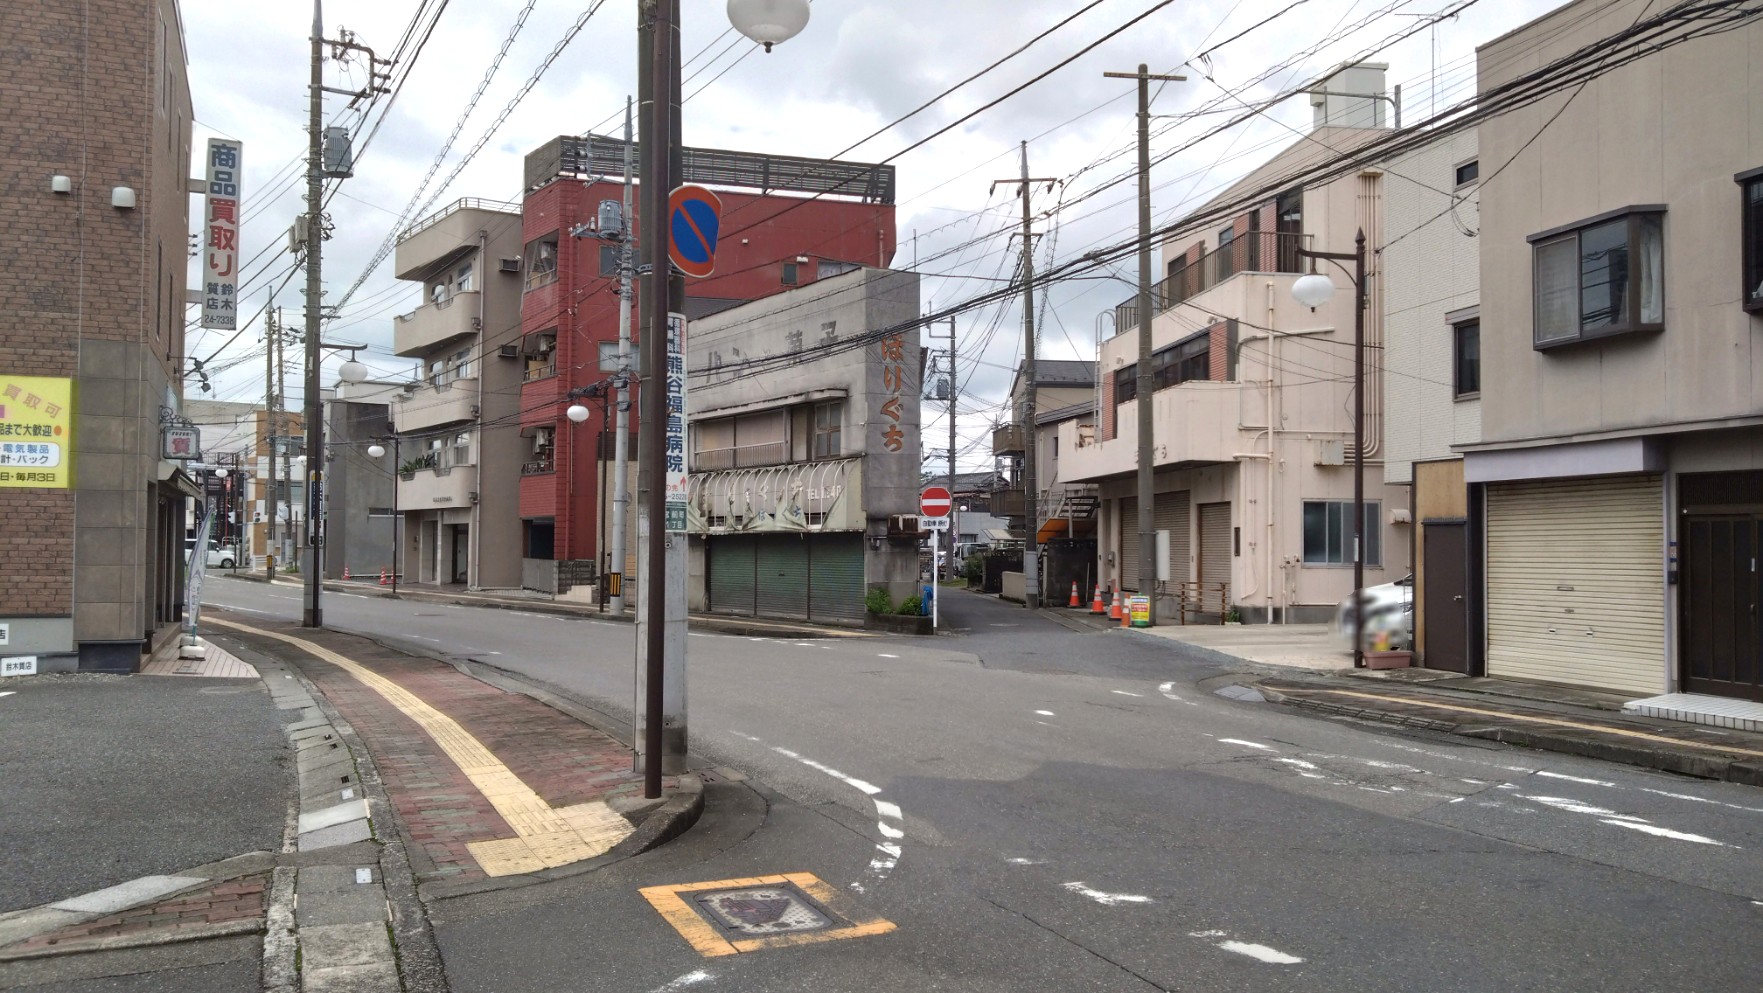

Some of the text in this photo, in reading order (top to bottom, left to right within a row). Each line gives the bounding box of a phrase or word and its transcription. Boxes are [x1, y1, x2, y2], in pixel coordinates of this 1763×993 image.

[208, 143, 238, 277] 商品買取り
[2, 383, 62, 419] 買取可
